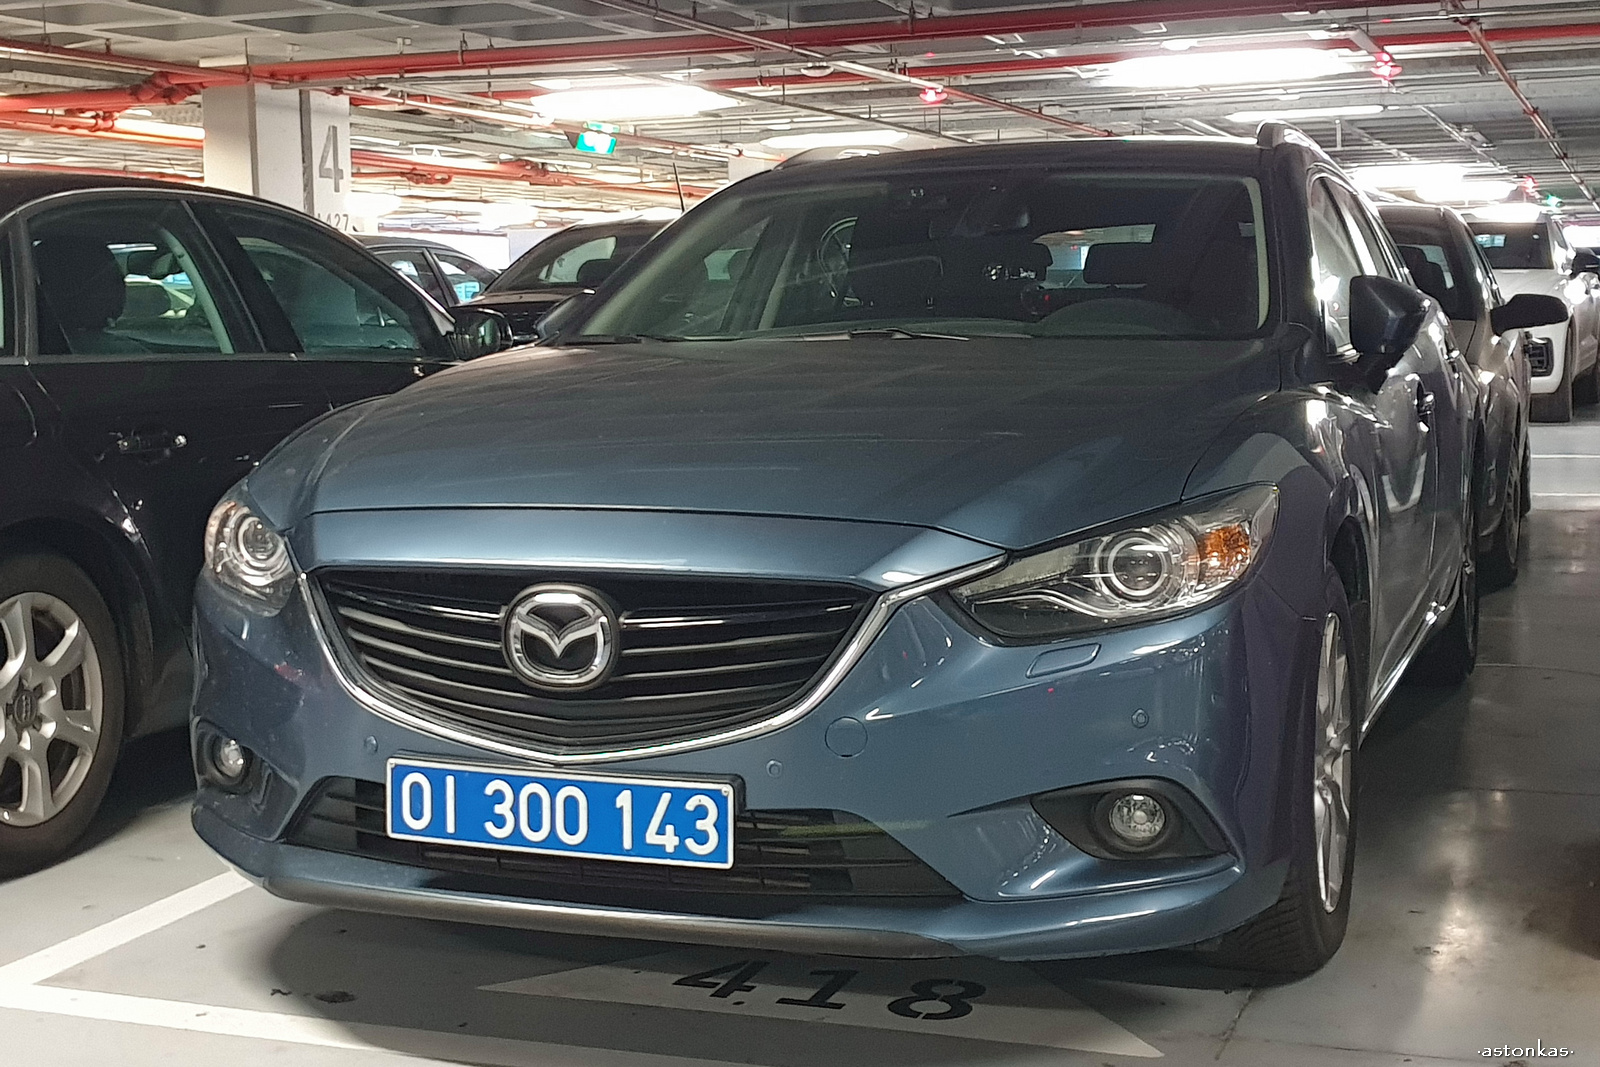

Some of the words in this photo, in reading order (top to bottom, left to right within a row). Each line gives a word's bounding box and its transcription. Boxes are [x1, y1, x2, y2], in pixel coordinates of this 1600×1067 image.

[318, 125, 344, 193] 4
[484, 779, 589, 846] 300
[615, 789, 719, 856] 143
